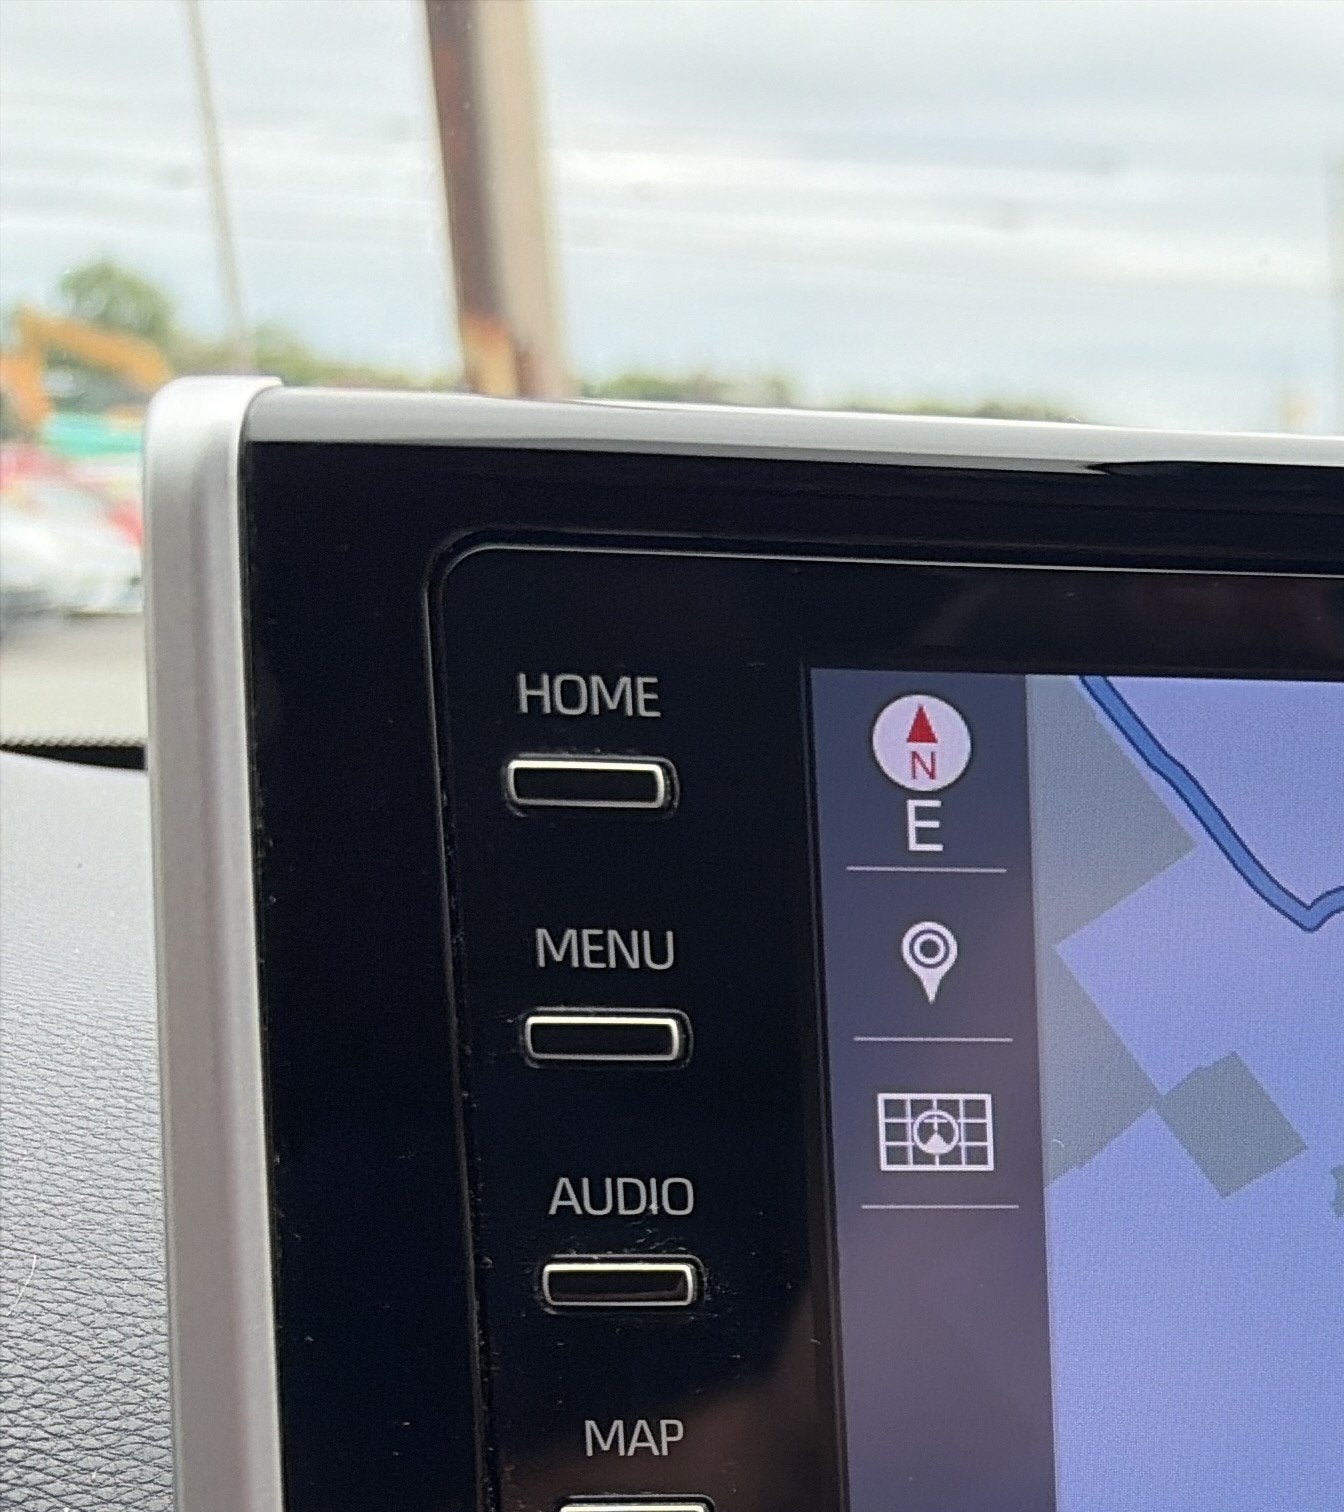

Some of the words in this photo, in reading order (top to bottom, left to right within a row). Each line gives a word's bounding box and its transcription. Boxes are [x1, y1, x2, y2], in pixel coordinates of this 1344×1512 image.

[518, 673, 661, 718] HOME
[911, 752, 936, 780] N
[908, 800, 943, 851] E
[535, 928, 675, 970] MENU
[548, 1178, 694, 1216] AUDIO
[584, 1419, 685, 1457] MAP
